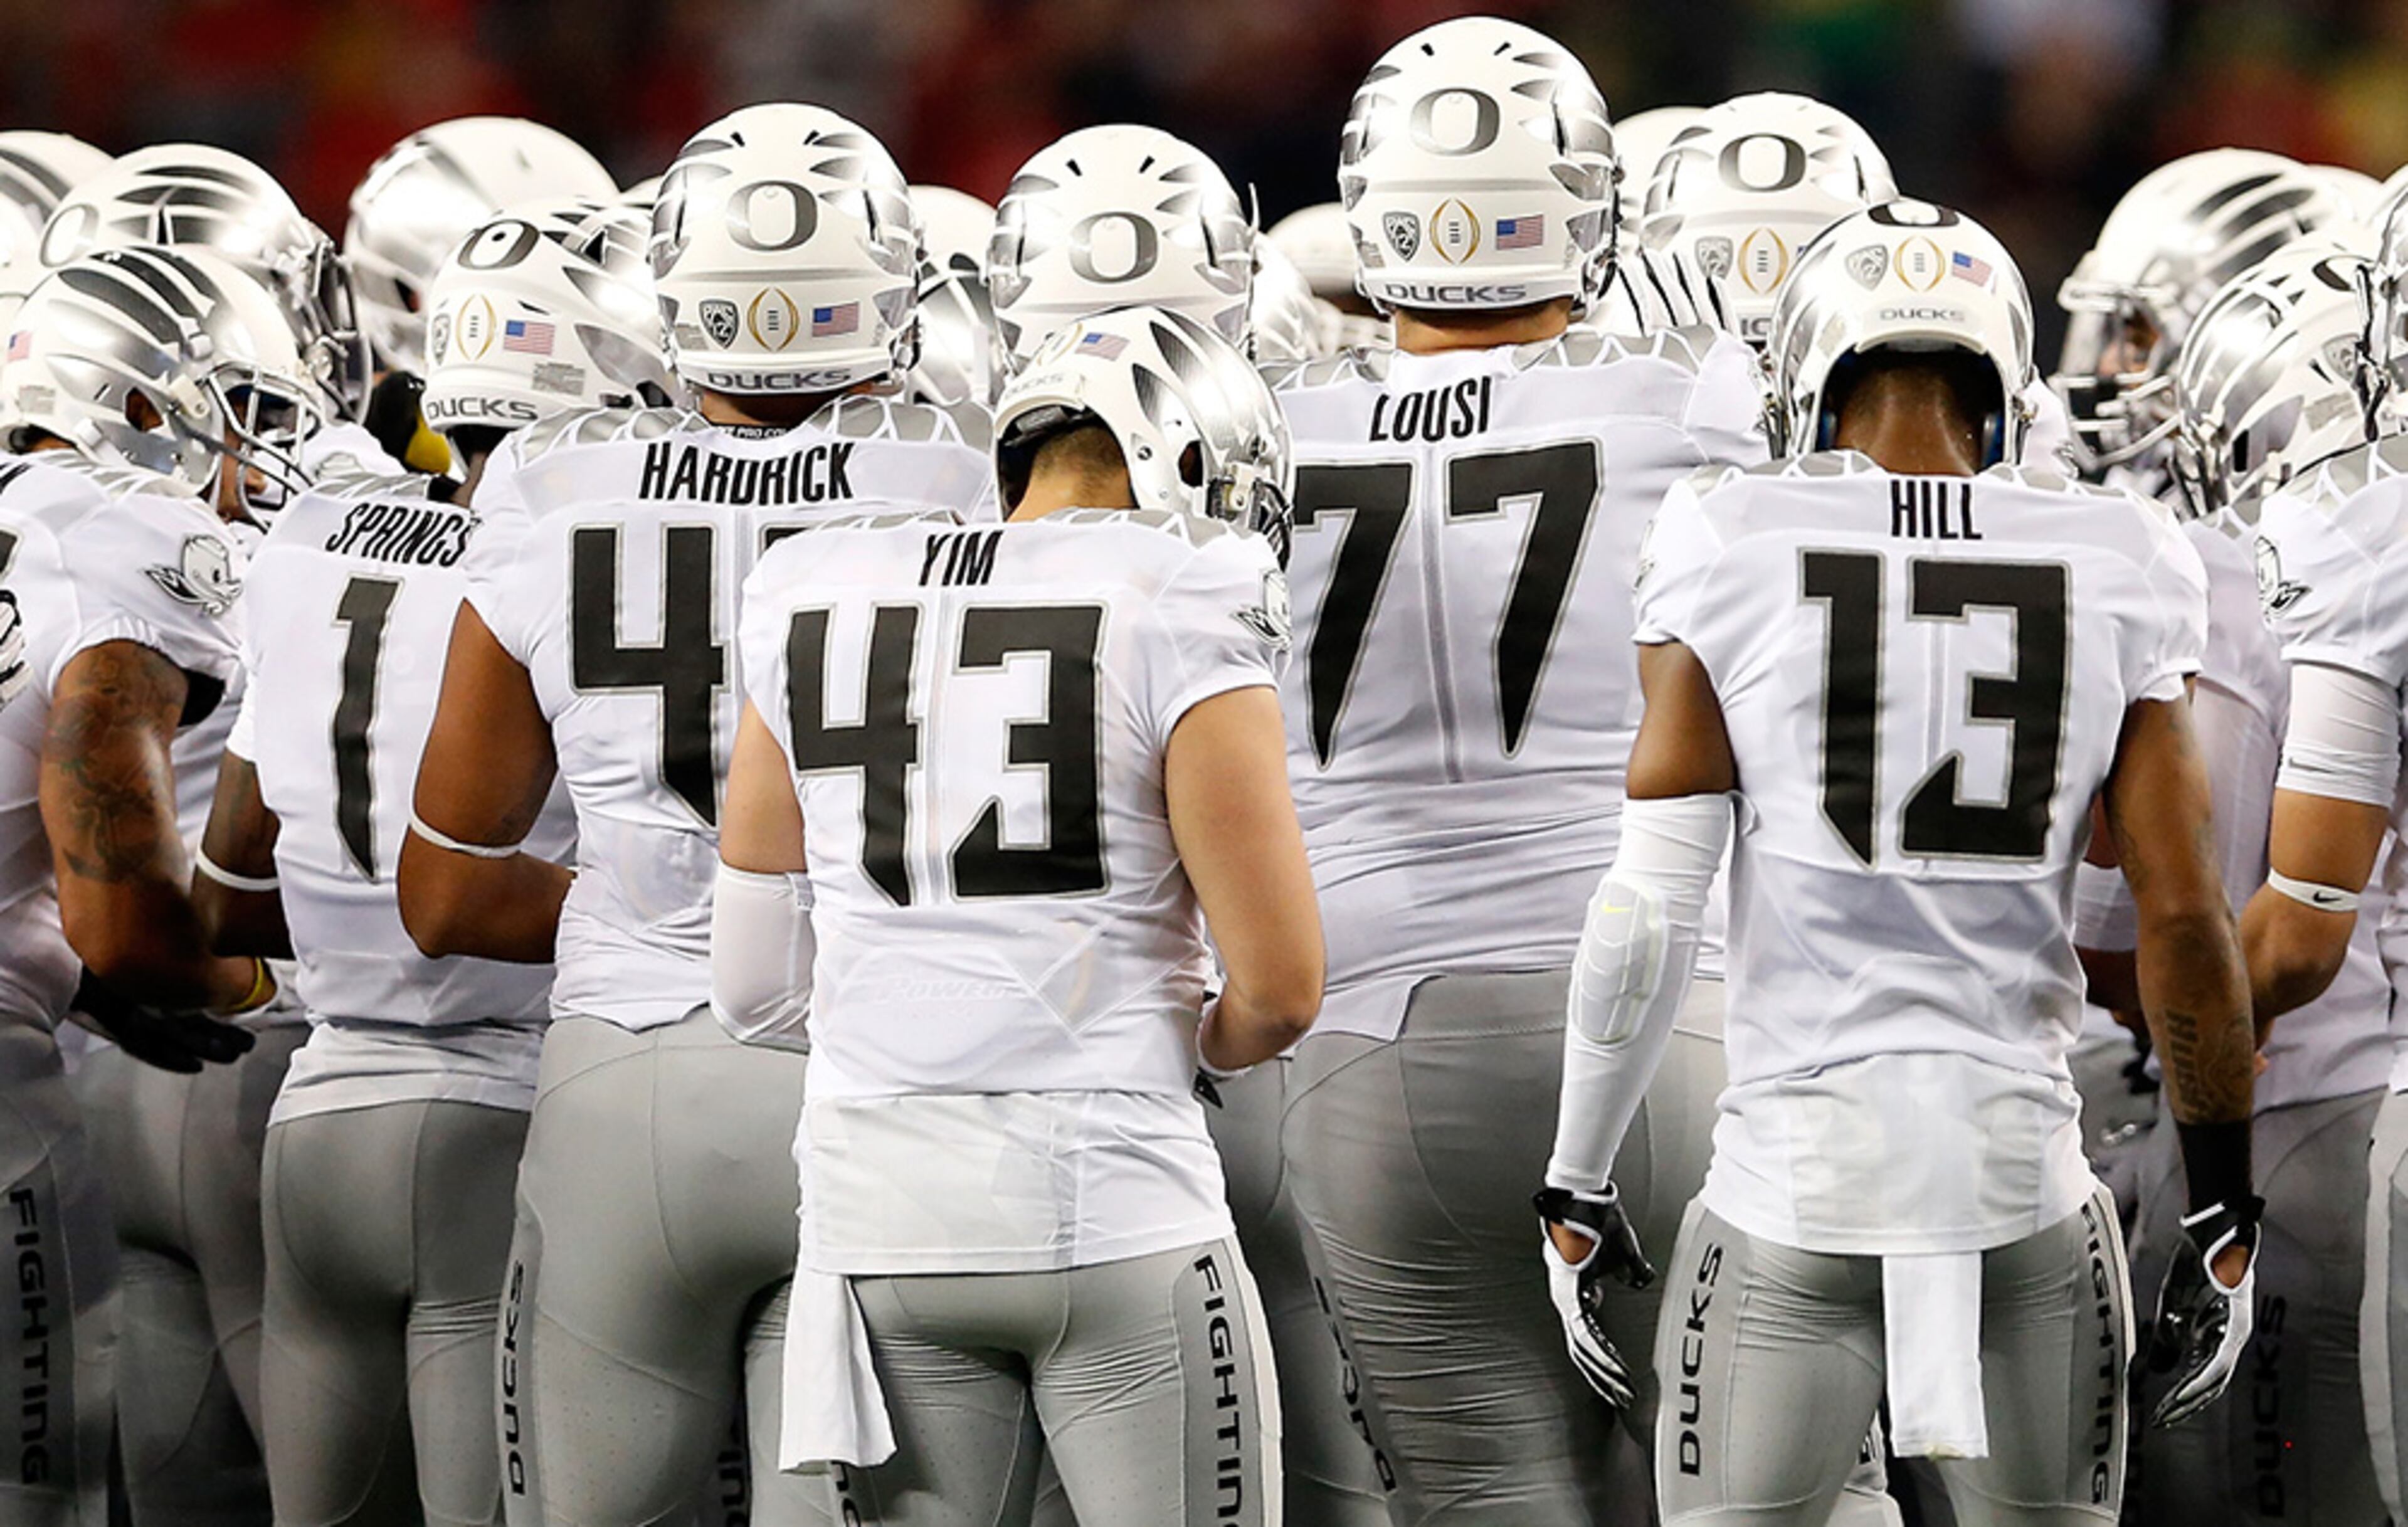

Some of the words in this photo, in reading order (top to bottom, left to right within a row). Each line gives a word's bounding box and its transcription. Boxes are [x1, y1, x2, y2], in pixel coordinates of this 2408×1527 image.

[708, 369, 852, 390] DUCKS
[1385, 283, 1526, 304] DUCKS
[1879, 307, 1965, 322] DUCKS
[428, 397, 539, 421] DUCKS
[639, 441, 854, 505] HARDRICK
[1370, 376, 1491, 441] LOUSI
[1890, 480, 1982, 539] HILL
[325, 503, 471, 567] SPRINGS
[918, 531, 1003, 586] YIM
[1294, 438, 1603, 770] 77
[330, 572, 404, 885] 1
[568, 520, 819, 829] 4
[784, 601, 1110, 908] 43
[1797, 546, 2072, 872] 13
[9, 1188, 48, 1484] FIGHTING
[502, 1259, 525, 1496] DUCKS
[1194, 1254, 1243, 1527] FIGHTIN
[1679, 1242, 1723, 1477] DUCKS
[2080, 1203, 2116, 1504] FIGHTING
[2254, 1294, 2286, 1518] DUCKS
